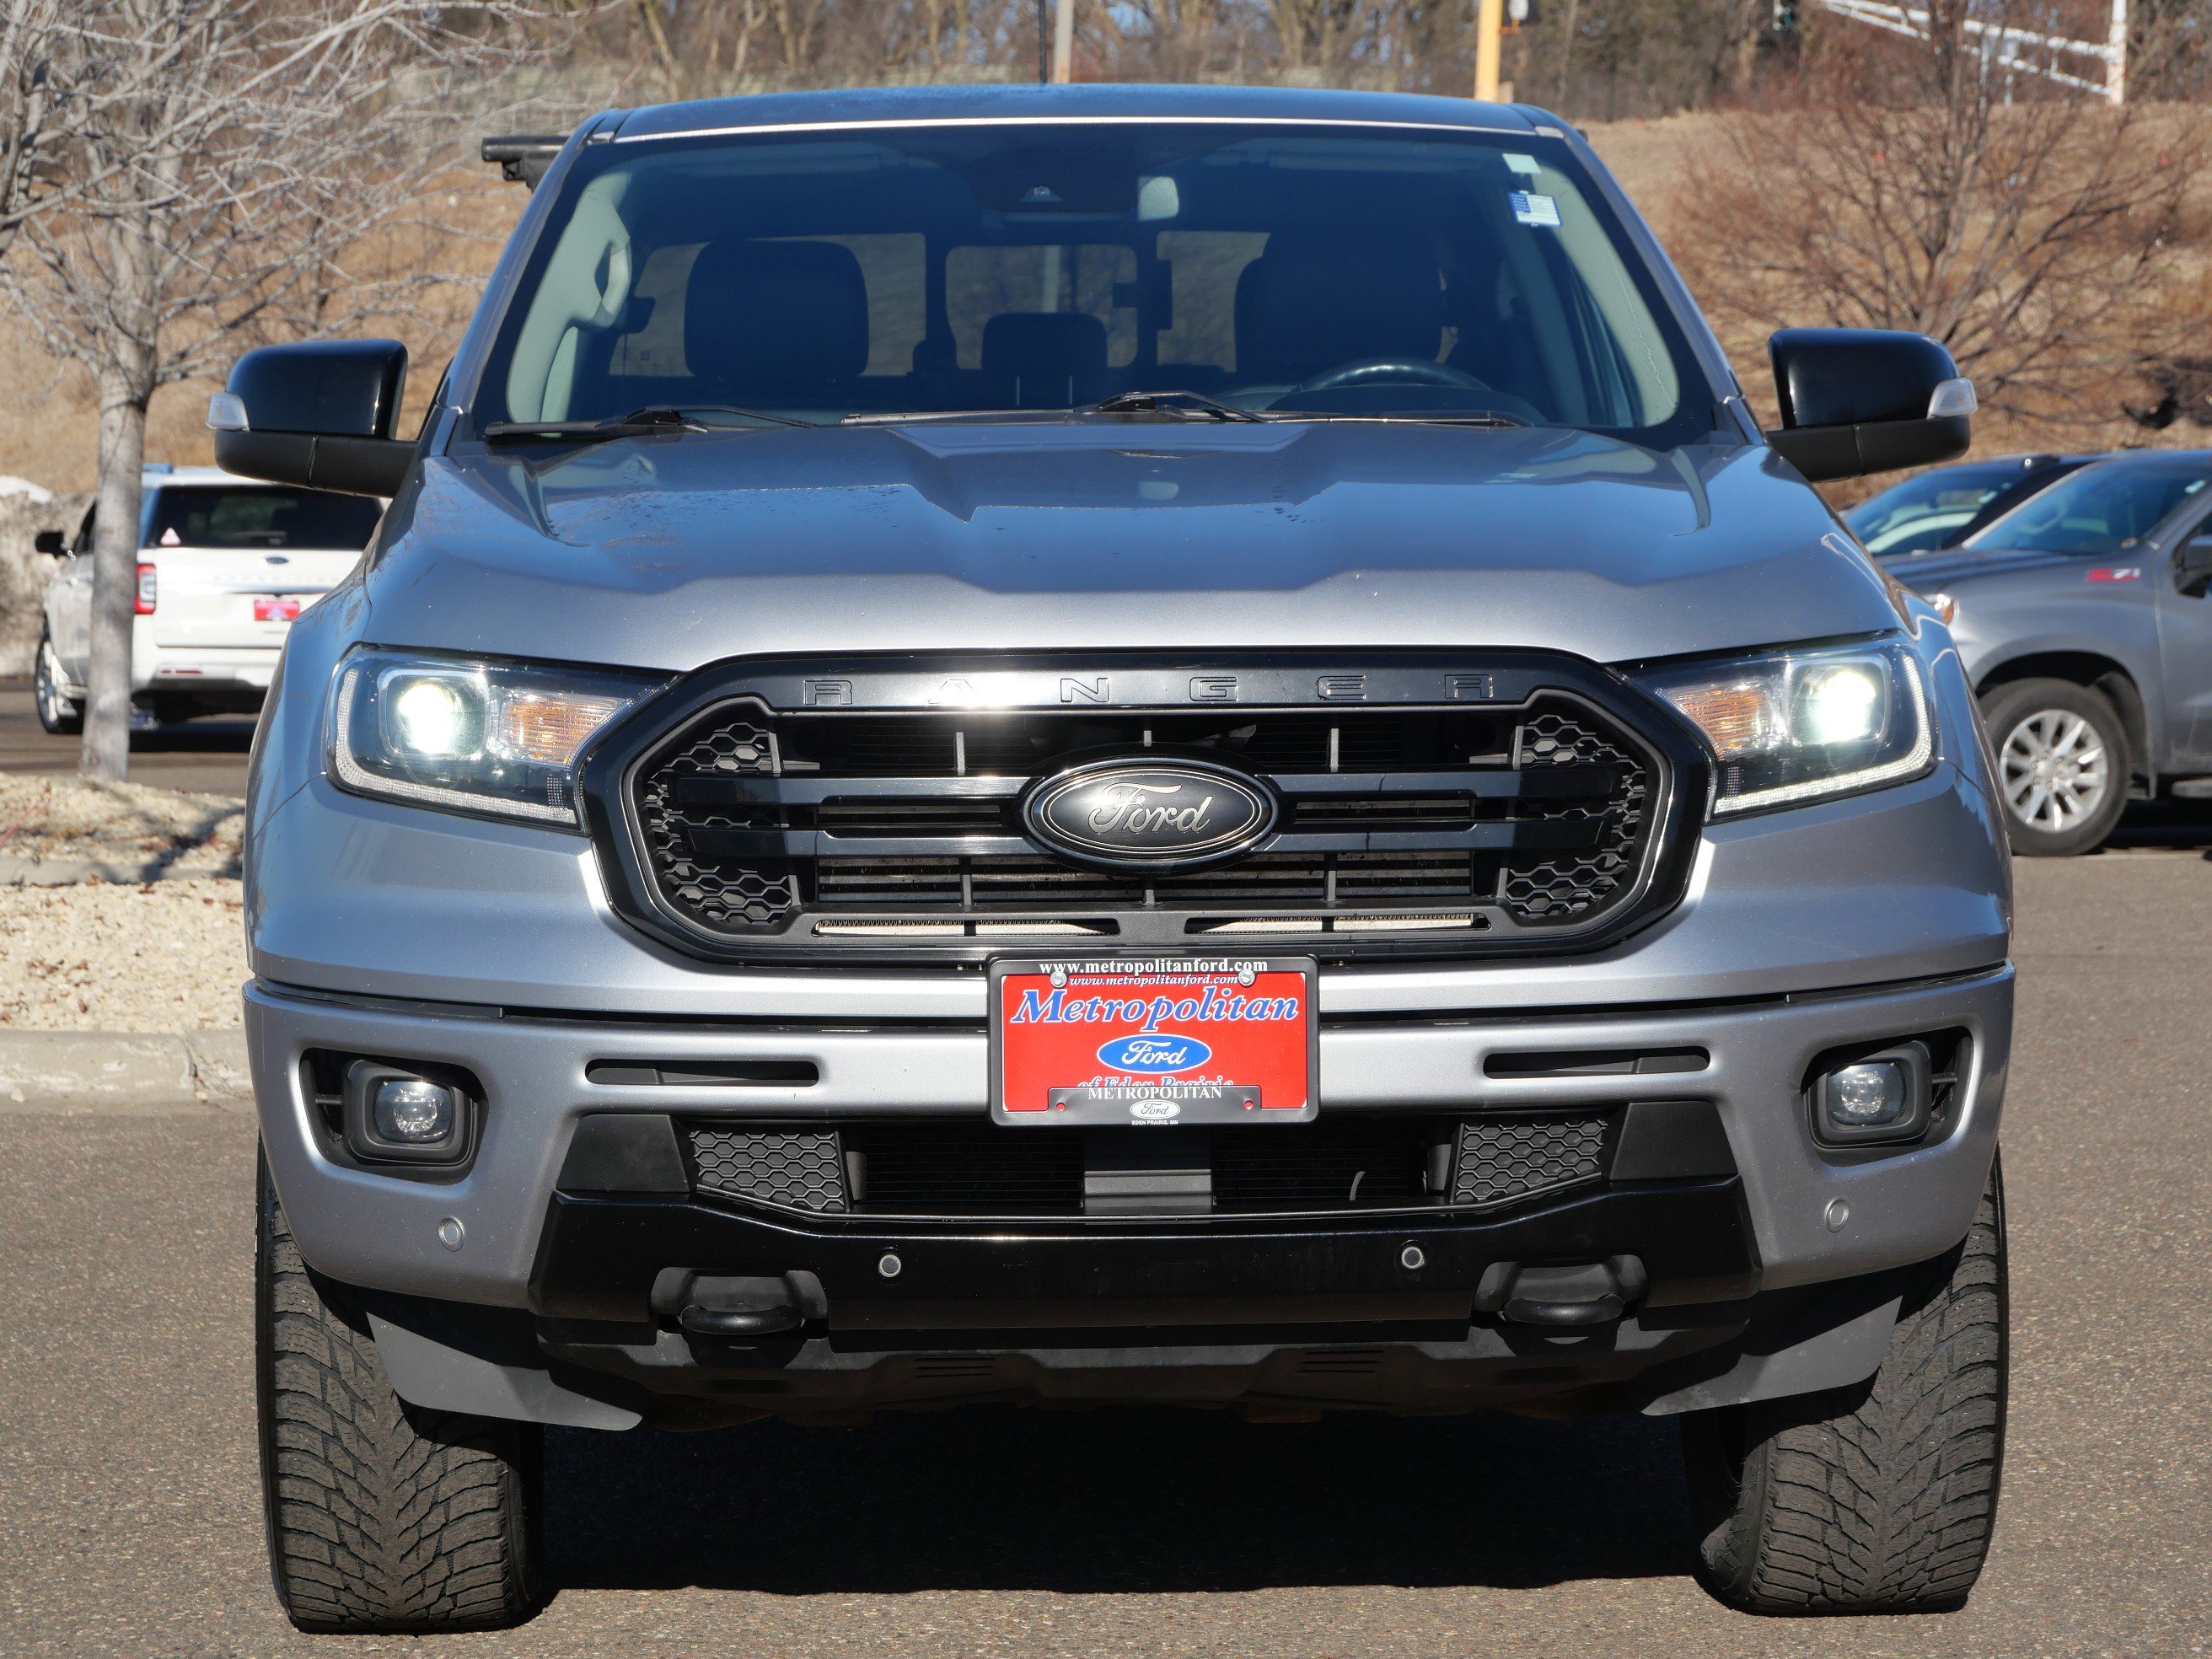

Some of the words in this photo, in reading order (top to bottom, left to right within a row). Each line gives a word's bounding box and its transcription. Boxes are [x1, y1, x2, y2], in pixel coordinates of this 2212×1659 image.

[1088, 782, 1214, 833] Ford
[1039, 958, 1268, 976] www.metropolitanford.com
[1070, 974, 1238, 987] www.metropolitanford.com
[1010, 985, 1299, 1033] Metropolitan
[1121, 1040, 1188, 1065] Ford
[1088, 1086, 1222, 1099] METROPOLITAN
[1141, 1103, 1169, 1114] Ford
